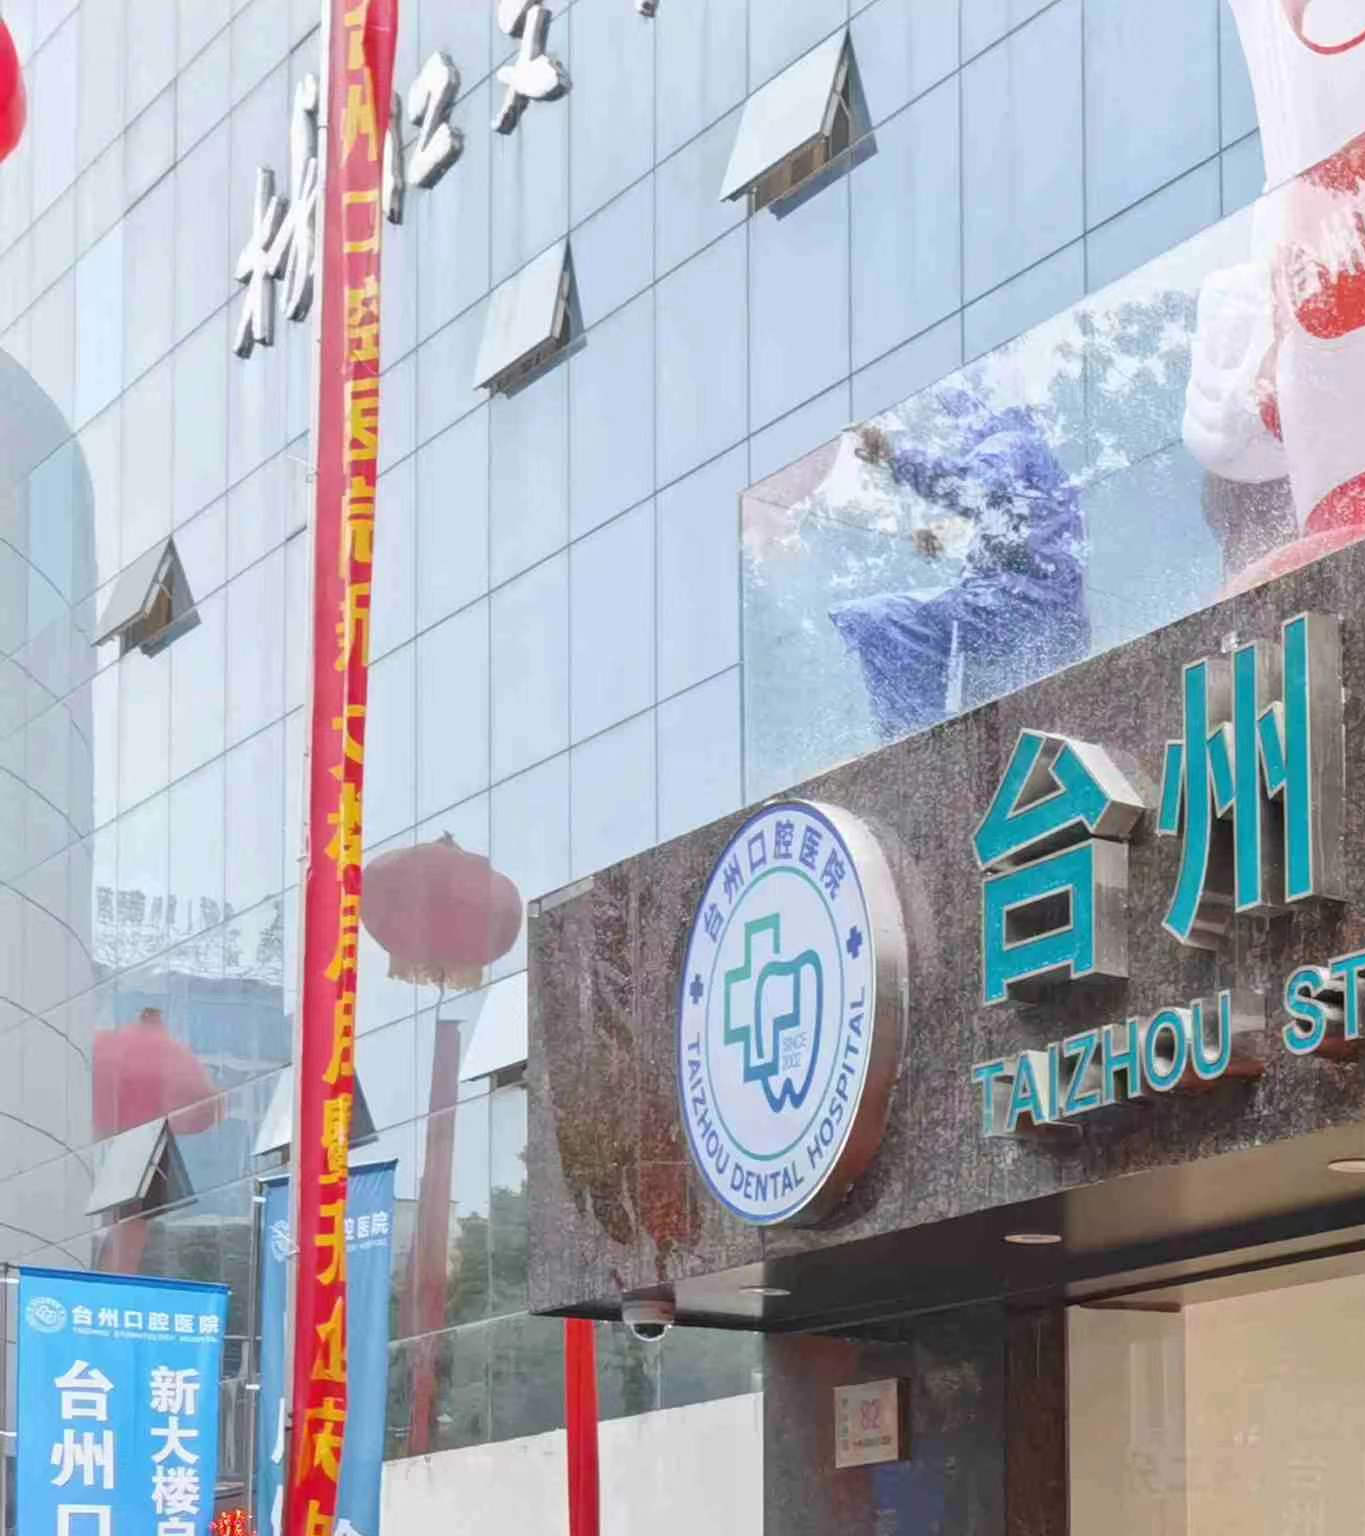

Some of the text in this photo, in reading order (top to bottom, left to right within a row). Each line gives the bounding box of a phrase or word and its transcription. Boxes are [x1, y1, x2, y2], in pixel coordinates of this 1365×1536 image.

[704, 819, 846, 942] 台州口腔医院
[687, 984, 866, 1201] TAIZHOU DENTAL HOSPITAL
[973, 991, 1231, 1137] TAIZHOU
[72, 1305, 219, 1334] 台州口腔医院
